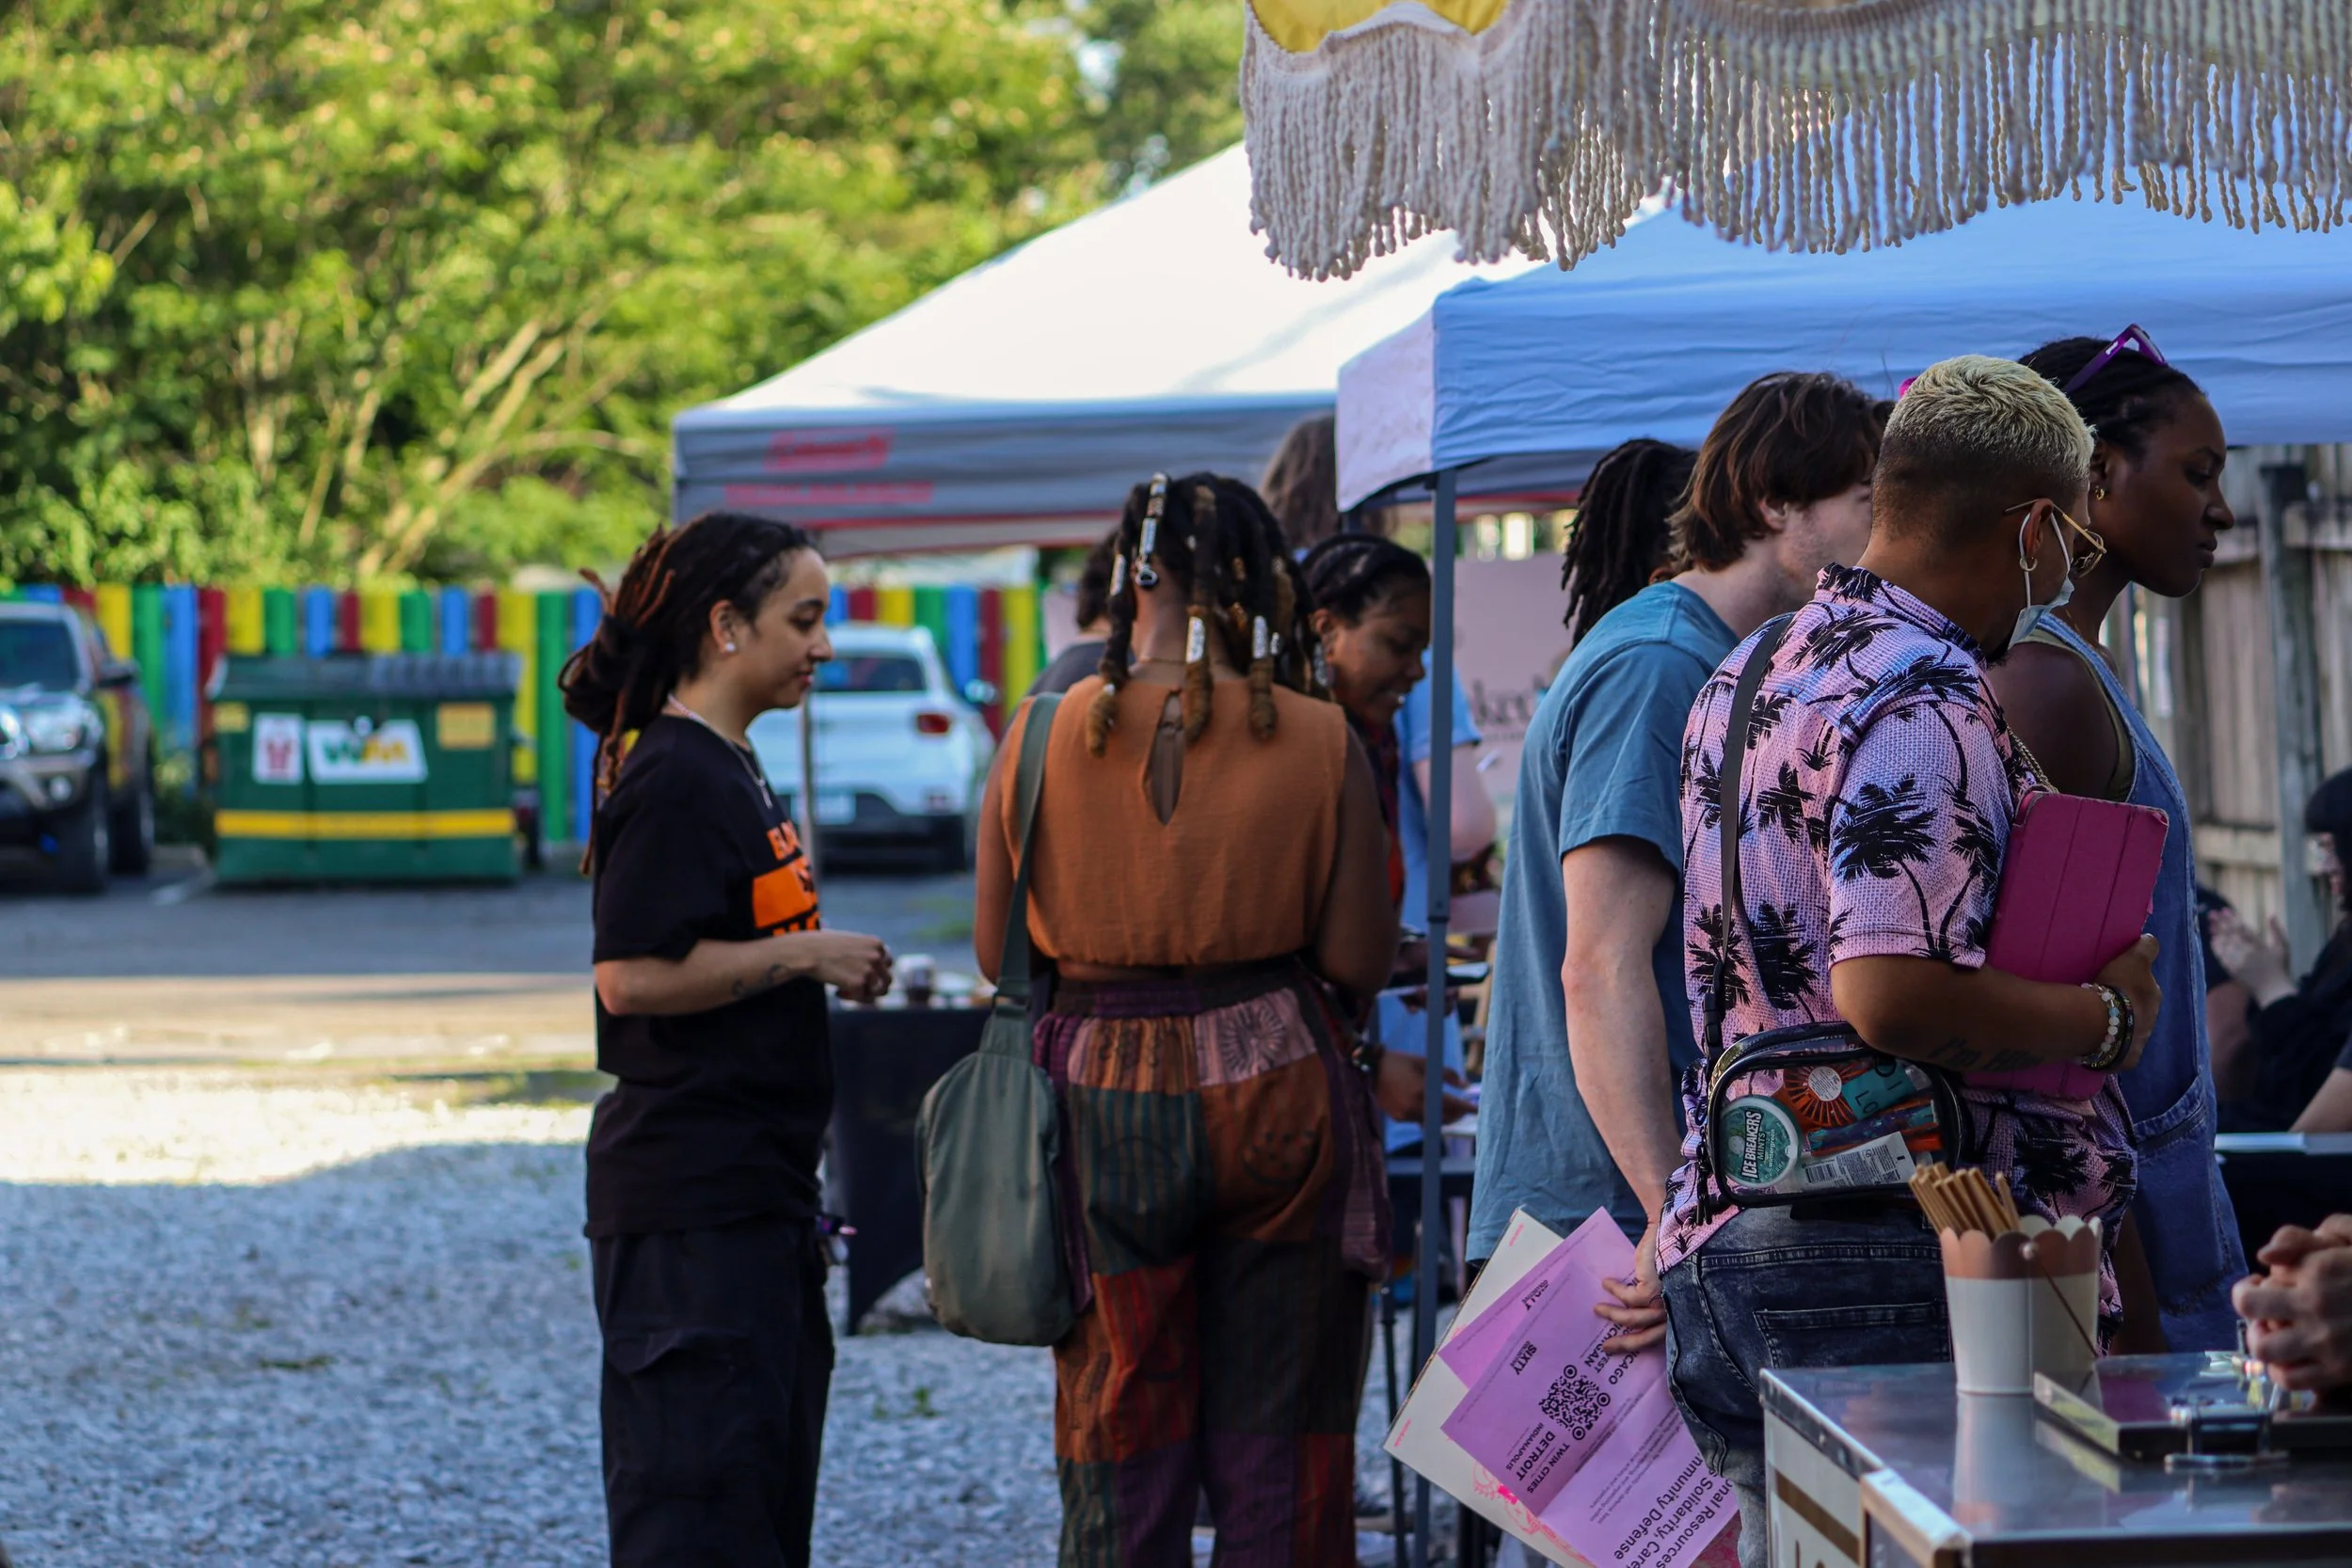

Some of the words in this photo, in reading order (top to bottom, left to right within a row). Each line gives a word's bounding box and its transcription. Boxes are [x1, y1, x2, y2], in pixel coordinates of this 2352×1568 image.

[1743, 1111, 1762, 1161] BREAKERS
[1756, 1132, 1767, 1161] MINTS
[1767, 1128, 1777, 1168] wintergreen
[1741, 1159, 1758, 1179] ICE
[1514, 1344, 1536, 1374] SIXTY
[1507, 1422, 1543, 1469] INDIANAPOLIS
[1516, 1431, 1555, 1481] DETROIT
[1549, 1443, 1569, 1465] TWIN
[1527, 1466, 1549, 1493] CITIES
[1657, 1456, 1703, 1509] mmunity
[1654, 1477, 1712, 1538] Solidarity,
[1613, 1508, 1661, 1559] Defense
[1656, 1507, 1714, 1568] Resources
